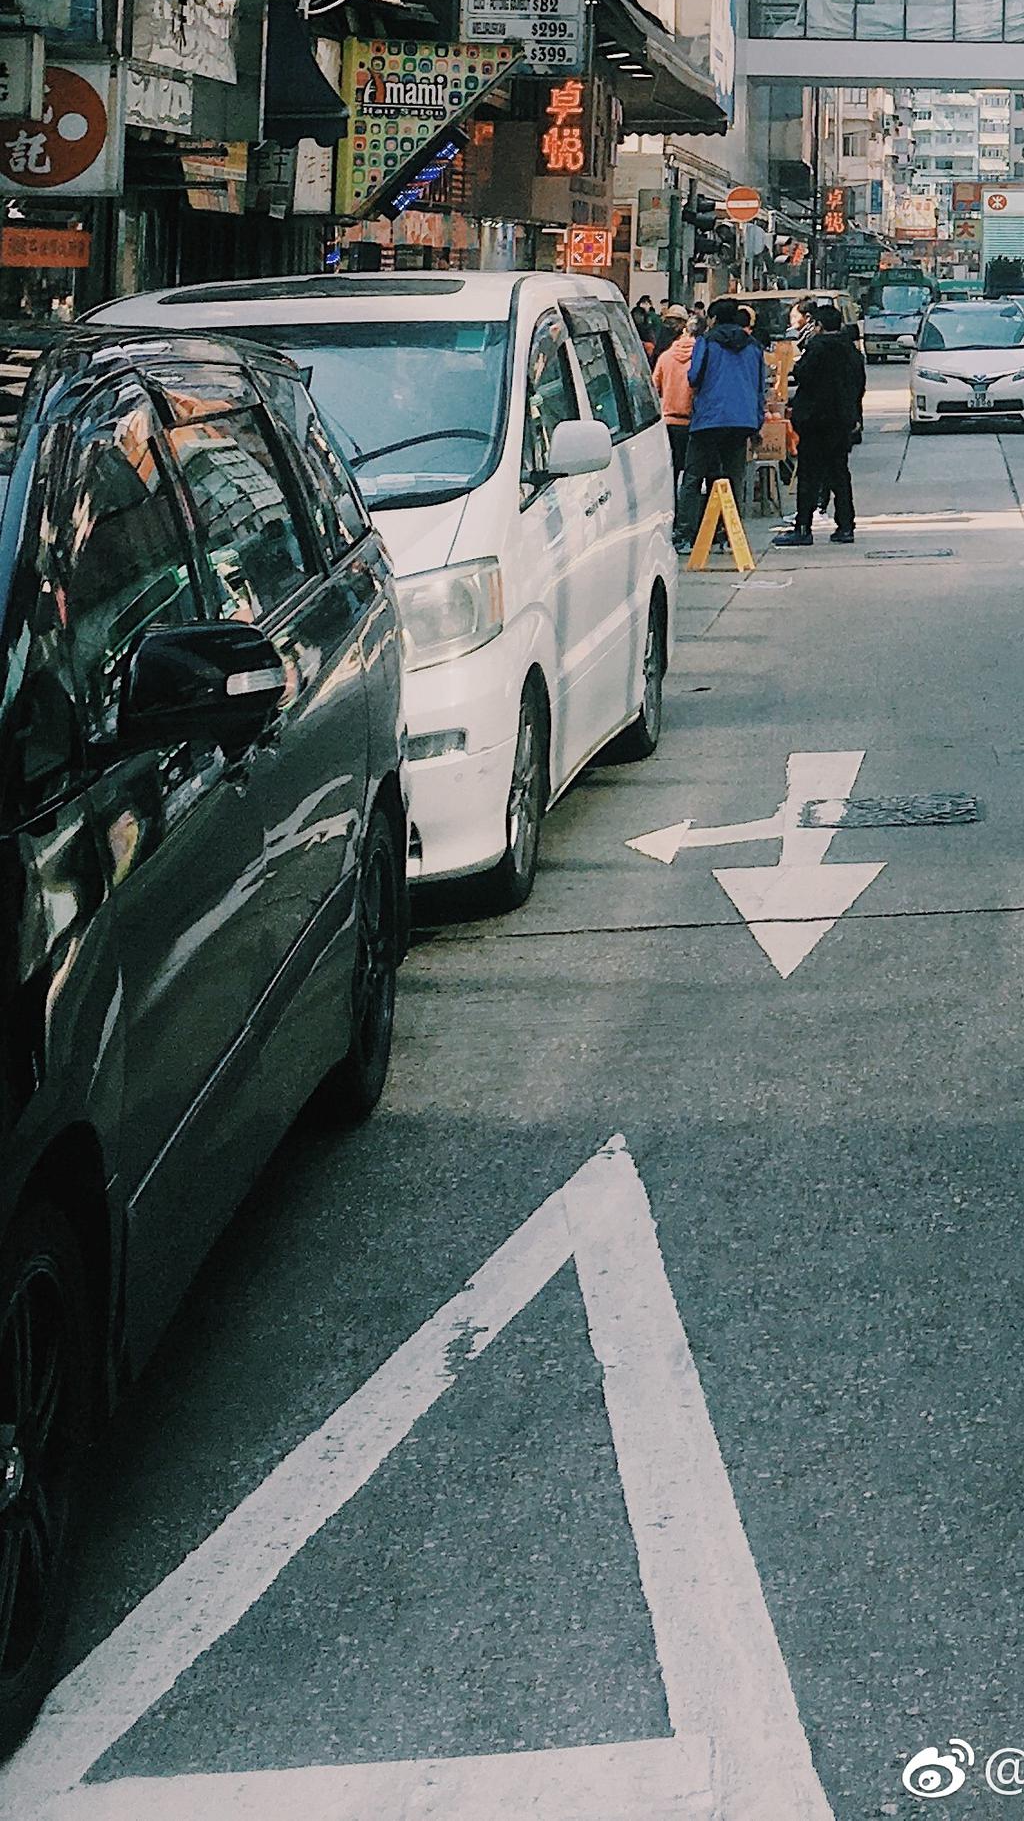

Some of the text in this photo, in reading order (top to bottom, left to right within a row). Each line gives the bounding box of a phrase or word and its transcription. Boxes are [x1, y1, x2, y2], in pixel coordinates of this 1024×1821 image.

[531, 21, 568, 38] $299
[530, 46, 567, 63] $399
[363, 68, 445, 106] Amami
[363, 107, 445, 117] Hair Salon
